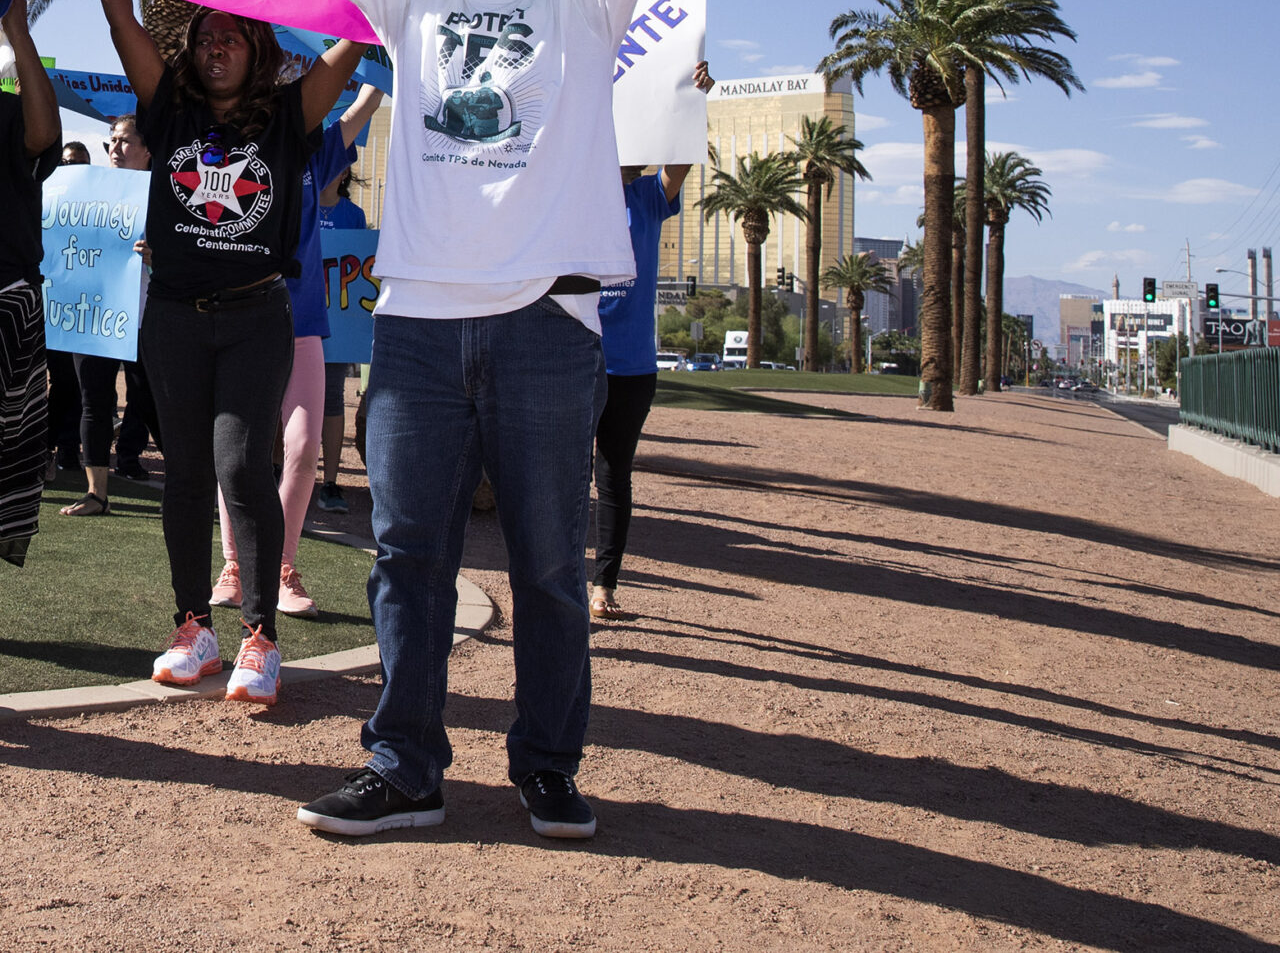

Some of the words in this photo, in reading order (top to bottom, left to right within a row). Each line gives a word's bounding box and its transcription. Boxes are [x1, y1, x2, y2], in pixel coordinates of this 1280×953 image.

[720, 80, 784, 96] MANDALAY
[787, 78, 810, 91] BAY
[421, 153, 446, 163] Comité
[448, 154, 468, 165] TPS
[471, 158, 485, 167] de
[488, 159, 528, 169] Nevada
[203, 170, 231, 193] 100
[201, 192, 230, 200] YEARS
[42, 187, 140, 240] Journey
[61, 233, 102, 271] for
[322, 254, 381, 313] TPS
[1206, 321, 1244, 336] TAO
